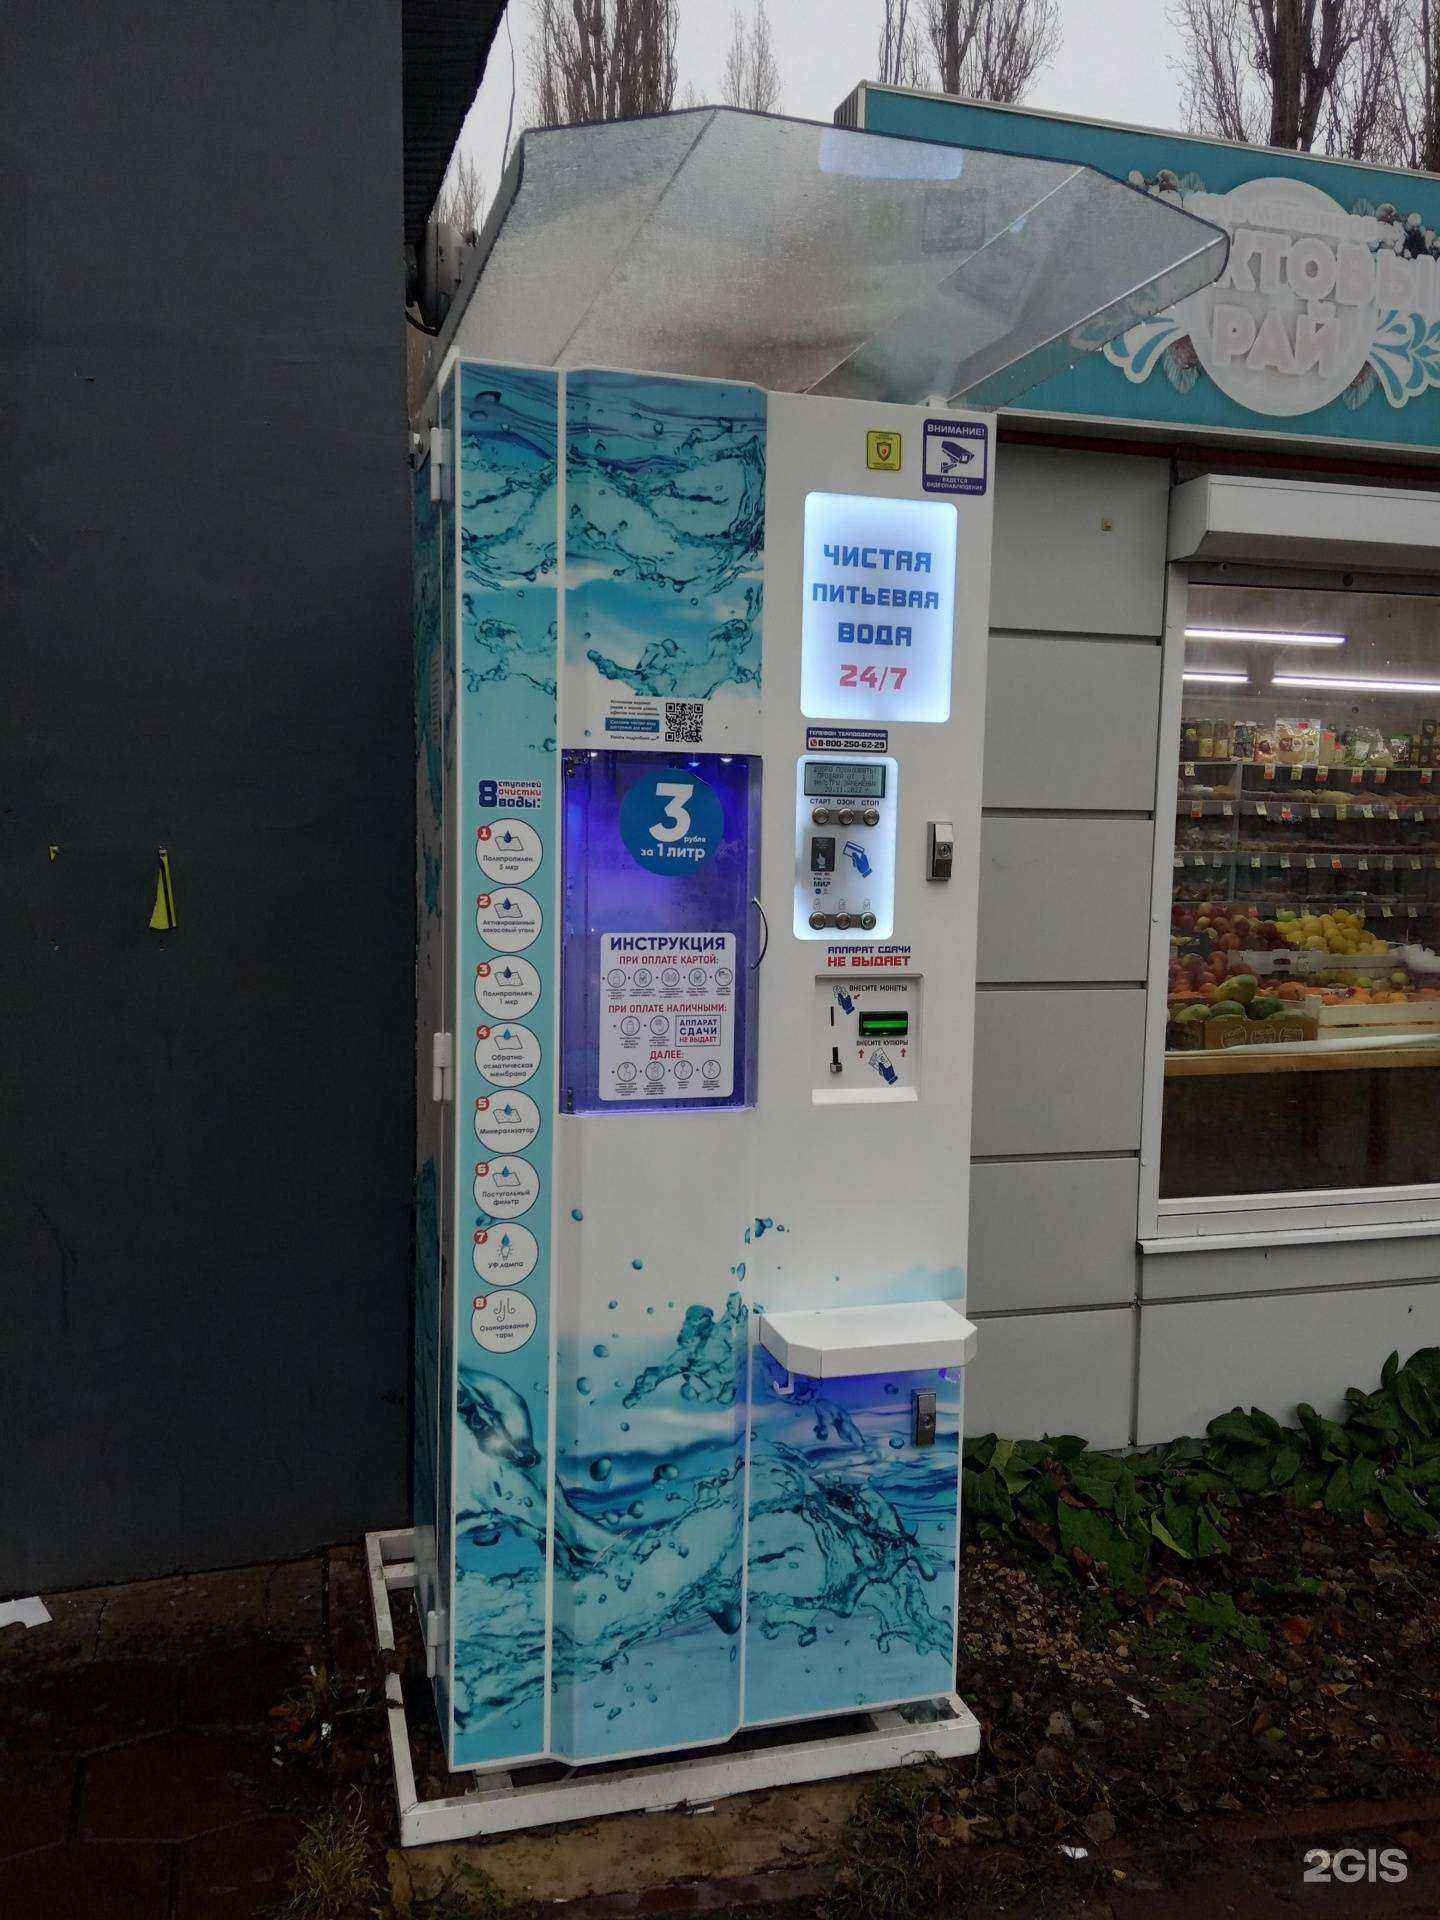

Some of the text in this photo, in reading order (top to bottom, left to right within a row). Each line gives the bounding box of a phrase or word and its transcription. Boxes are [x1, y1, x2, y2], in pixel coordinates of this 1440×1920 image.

[1213, 299, 1341, 381] РАЙ
[927, 423, 985, 437] ВНИМАНИЕ!
[823, 544, 931, 573] ЧИСТАЯ
[812, 582, 939, 609] ПИТЬЕВАЯ
[838, 622, 912, 646] ВОДА
[839, 664, 908, 691] 24/7
[478, 780, 542, 808] 8 ступеней
[498, 788, 542, 797] очистки
[498, 797, 541, 809] воды:
[649, 782, 694, 843] 3
[684, 836, 706, 844] рубля
[641, 843, 706, 862] за 1 литр
[610, 937, 725, 952] ИНСТРУКЦИЯ
[827, 946, 912, 954] АППАРАТ СДАЧИ
[619, 954, 719, 965] ПРИ ОПЛАТЕ КАРТОЙ:
[827, 956, 911, 967] НЕ ВЫДАЕТ
[608, 1003, 727, 1013] ПРИ ОПЛАТЕ НАЛИЧНЫМИ:
[479, 1027, 488, 1038] 4
[680, 1027, 717, 1036] СДАЧИ
[689, 1036, 717, 1044] ВЫДАЕТ
[650, 1050, 684, 1060] ДАЛЕЕ:
